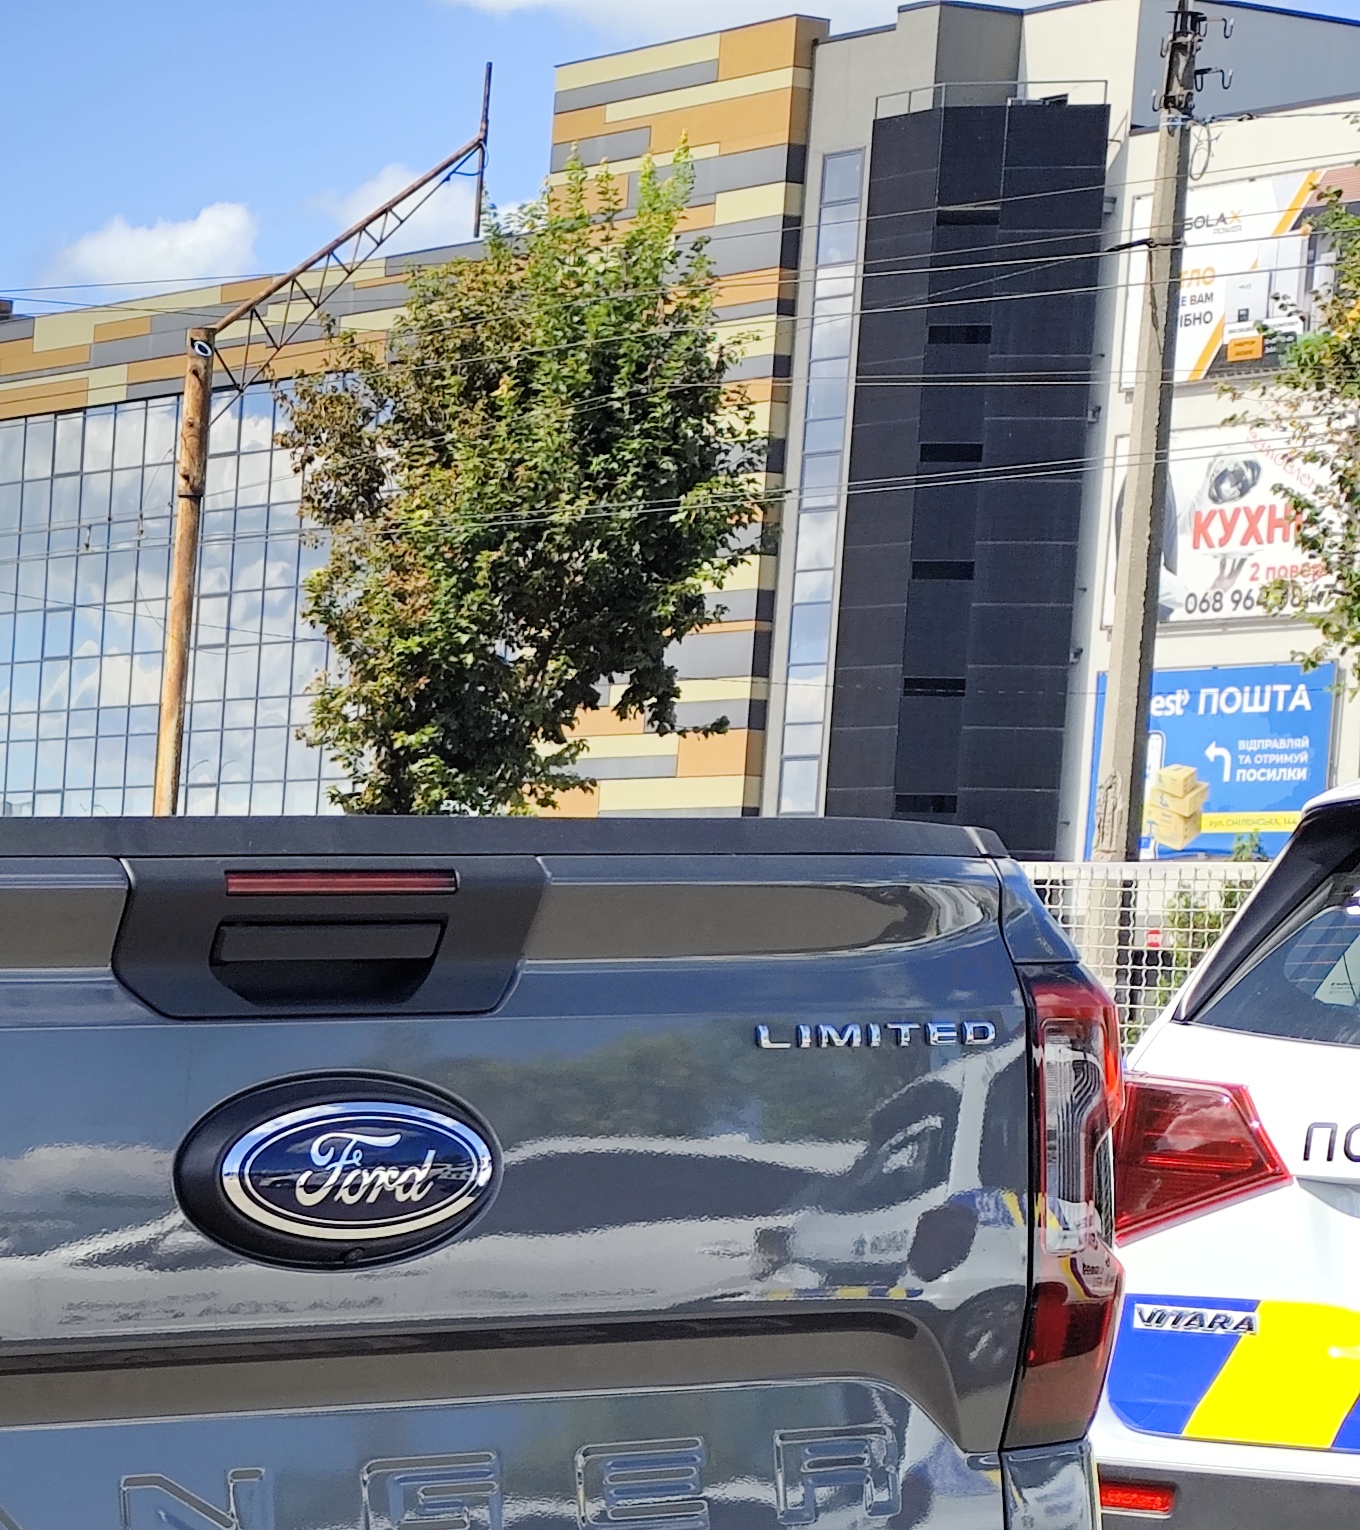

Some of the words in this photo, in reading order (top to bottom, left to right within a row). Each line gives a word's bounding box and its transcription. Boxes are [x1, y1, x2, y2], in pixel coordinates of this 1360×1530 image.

[1180, 310, 1213, 328] ІБНО
[1249, 562, 1260, 582] 2
[1185, 590, 1224, 614] 068
[1150, 688, 1185, 717] est
[1197, 684, 1312, 716] ПОШТА
[1238, 735, 1310, 752] ВІДПРАВЛЯЙ
[1238, 755, 1252, 765] ТА
[1253, 751, 1309, 765] ОТРИМУЙ
[1235, 767, 1308, 783] ПОСИЛКИ
[755, 1021, 997, 1049] LIMITED
[295, 1131, 435, 1207] Ford
[1136, 1306, 1257, 1336] VITARA
